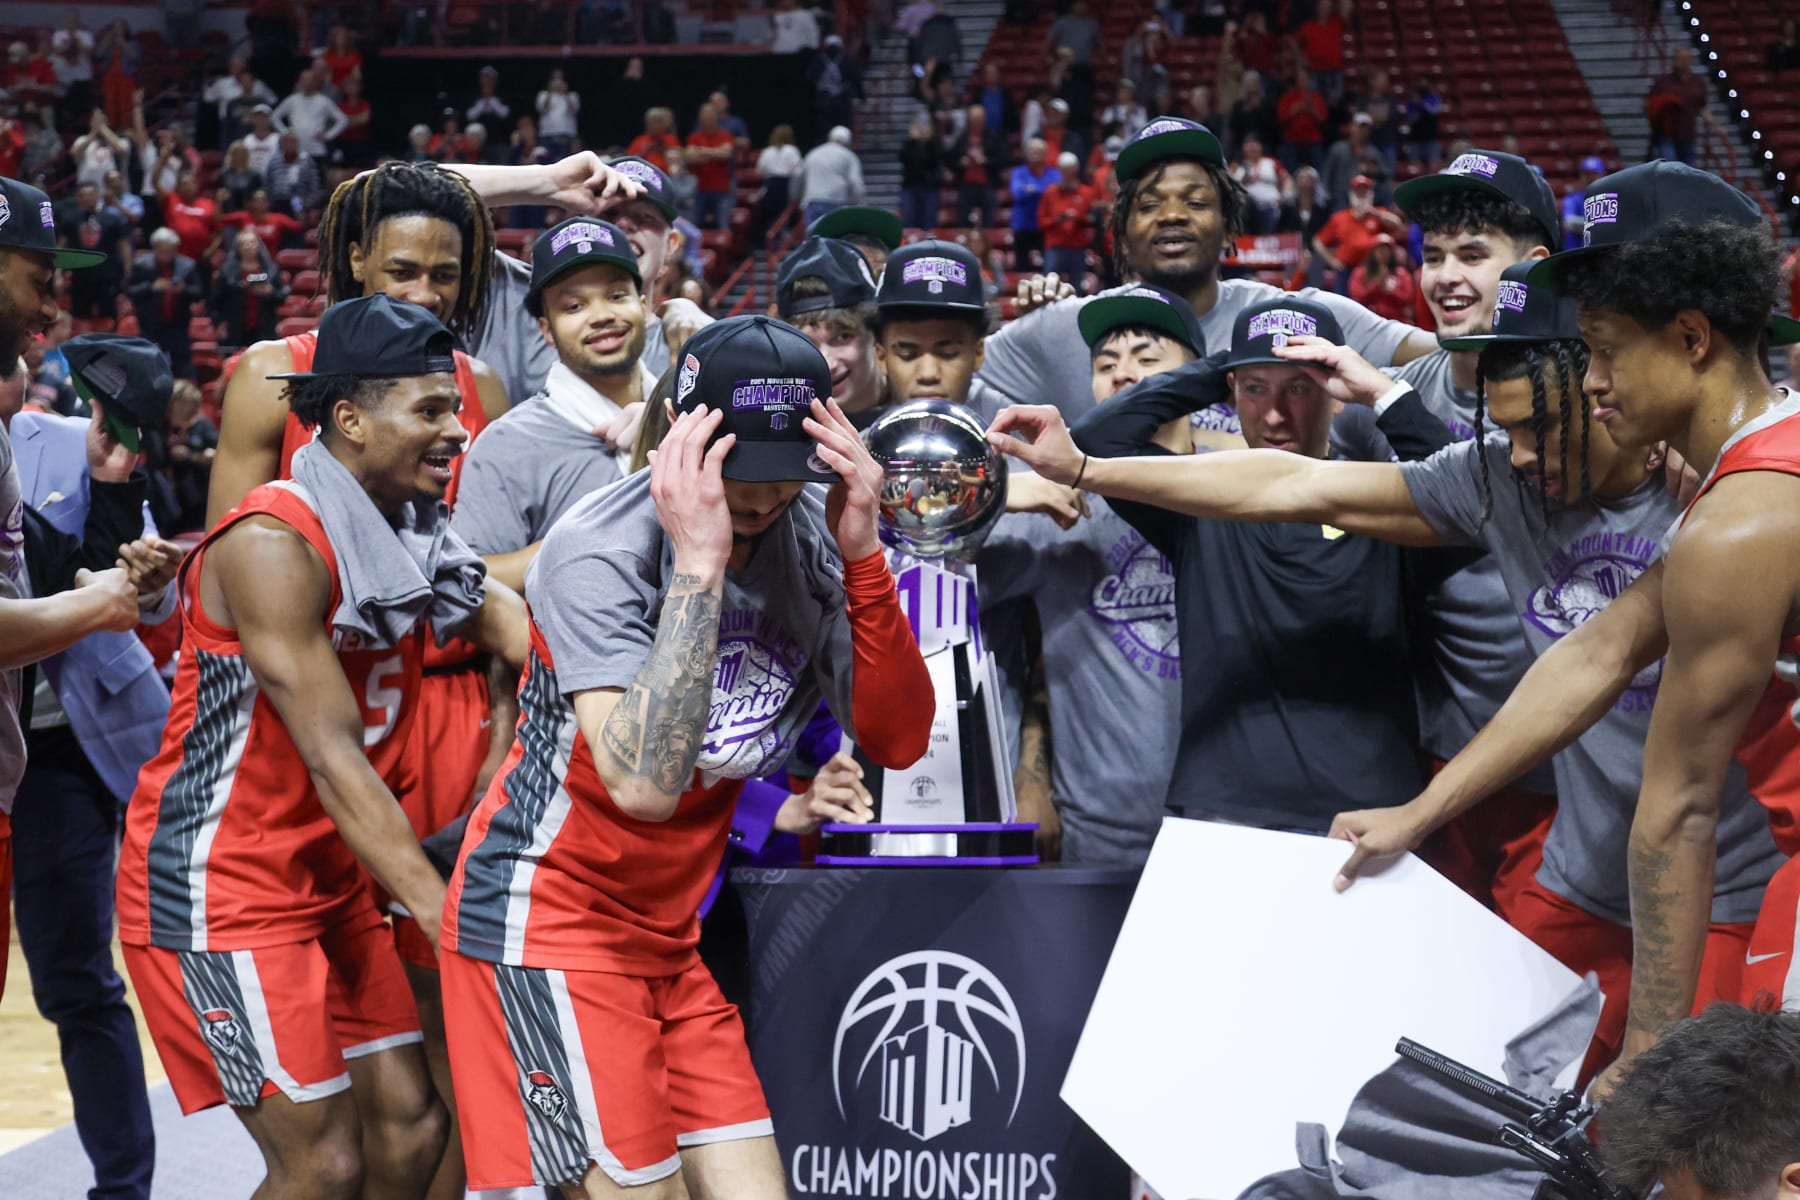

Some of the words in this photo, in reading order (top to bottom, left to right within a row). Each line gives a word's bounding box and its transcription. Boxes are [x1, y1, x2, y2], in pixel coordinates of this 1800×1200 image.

[1584, 200, 1618, 222] PIONS
[903, 261, 967, 283] CHAMPIONS
[1496, 286, 1527, 308] PIONS
[1247, 315, 1317, 337] CHAMPIONS
[732, 384, 817, 407] CHAMPIONS
[1571, 532, 1658, 562] MOUNTAIN
[759, 869, 868, 993] #MWMADN
[791, 1144, 1058, 1200] CHAMPIONSHIPS
